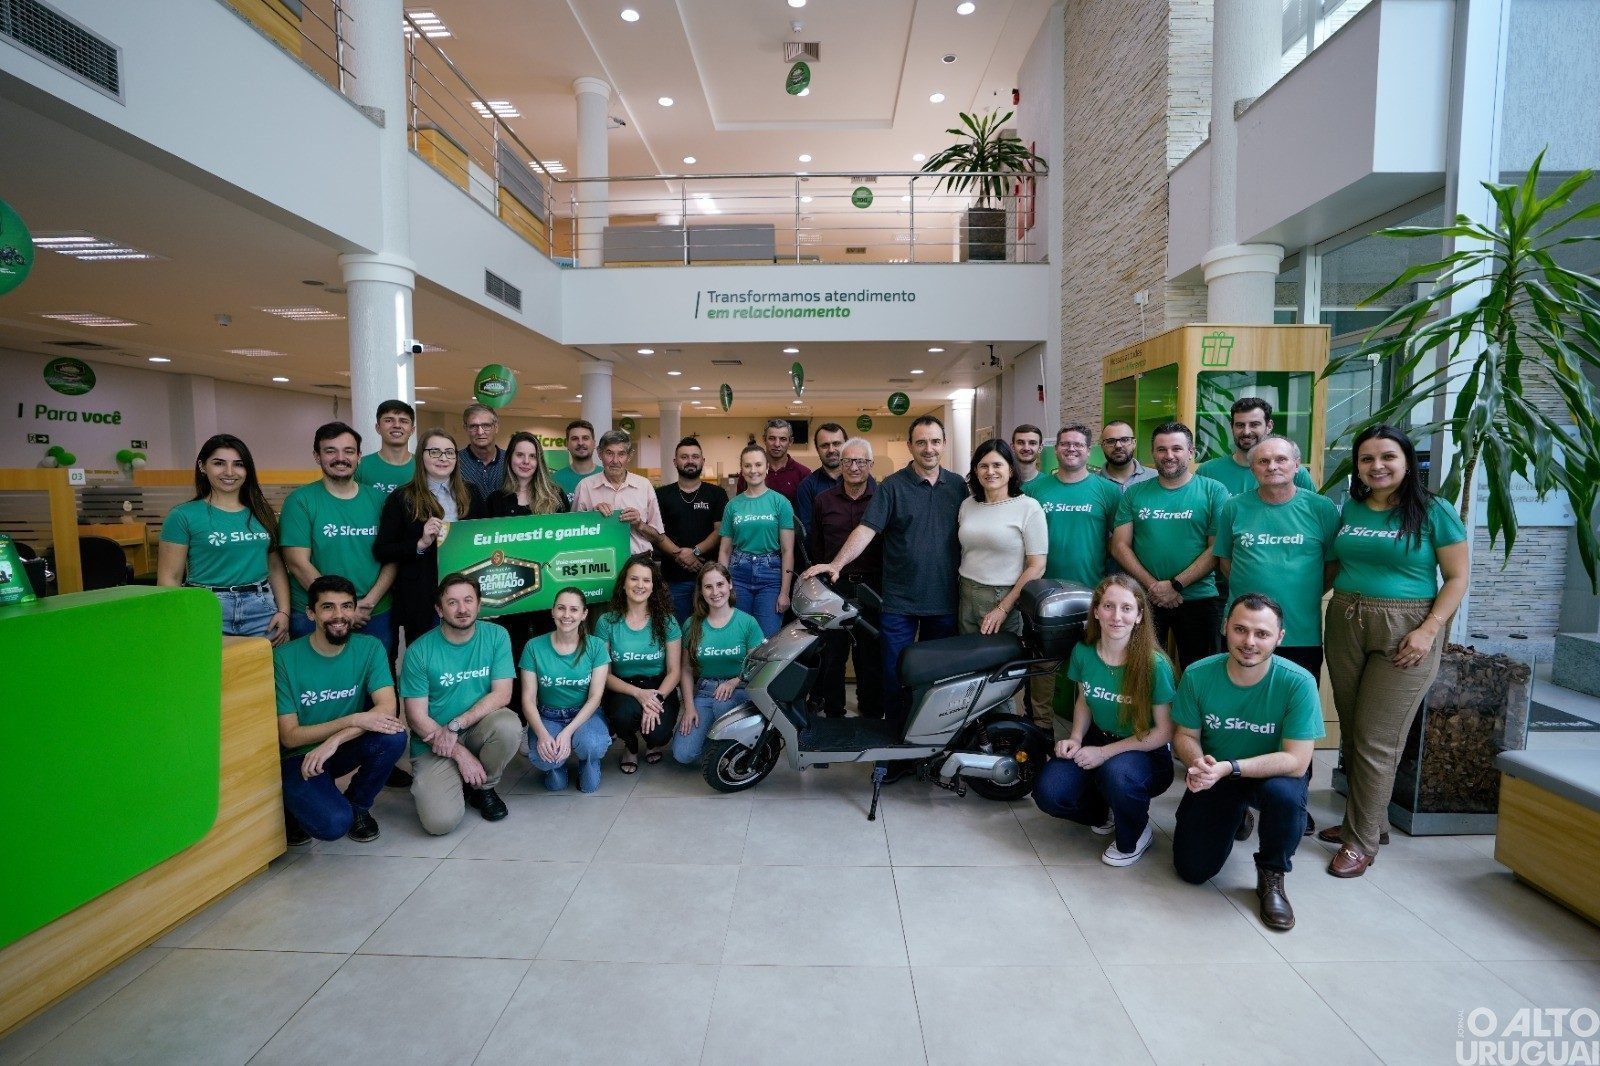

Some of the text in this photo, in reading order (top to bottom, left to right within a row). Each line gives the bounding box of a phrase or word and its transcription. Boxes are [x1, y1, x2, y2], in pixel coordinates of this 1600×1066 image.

[707, 290, 916, 303] Transformamos atendimento
[707, 306, 851, 319] em relacionamento
[35, 404, 122, 425] Para você
[539, 435, 567, 447] icre
[71, 473, 83, 481] 03
[1055, 503, 1093, 513] Sicredi
[1152, 508, 1193, 520] Sicredi
[230, 531, 270, 542] Sicre
[340, 525, 378, 536] Sicredi
[473, 524, 601, 546] Eu investi e ganhei
[1257, 533, 1304, 545] Sicredi
[562, 564, 579, 576] R$
[580, 564, 586, 575] 1
[588, 563, 611, 574] MIL
[478, 571, 519, 584] CAPITAL
[480, 578, 525, 592] REMIADO
[704, 645, 741, 656] Sicredi
[319, 684, 359, 702] Sicred
[1092, 686, 1132, 704] Sicred
[1224, 717, 1276, 734] Sicredi
